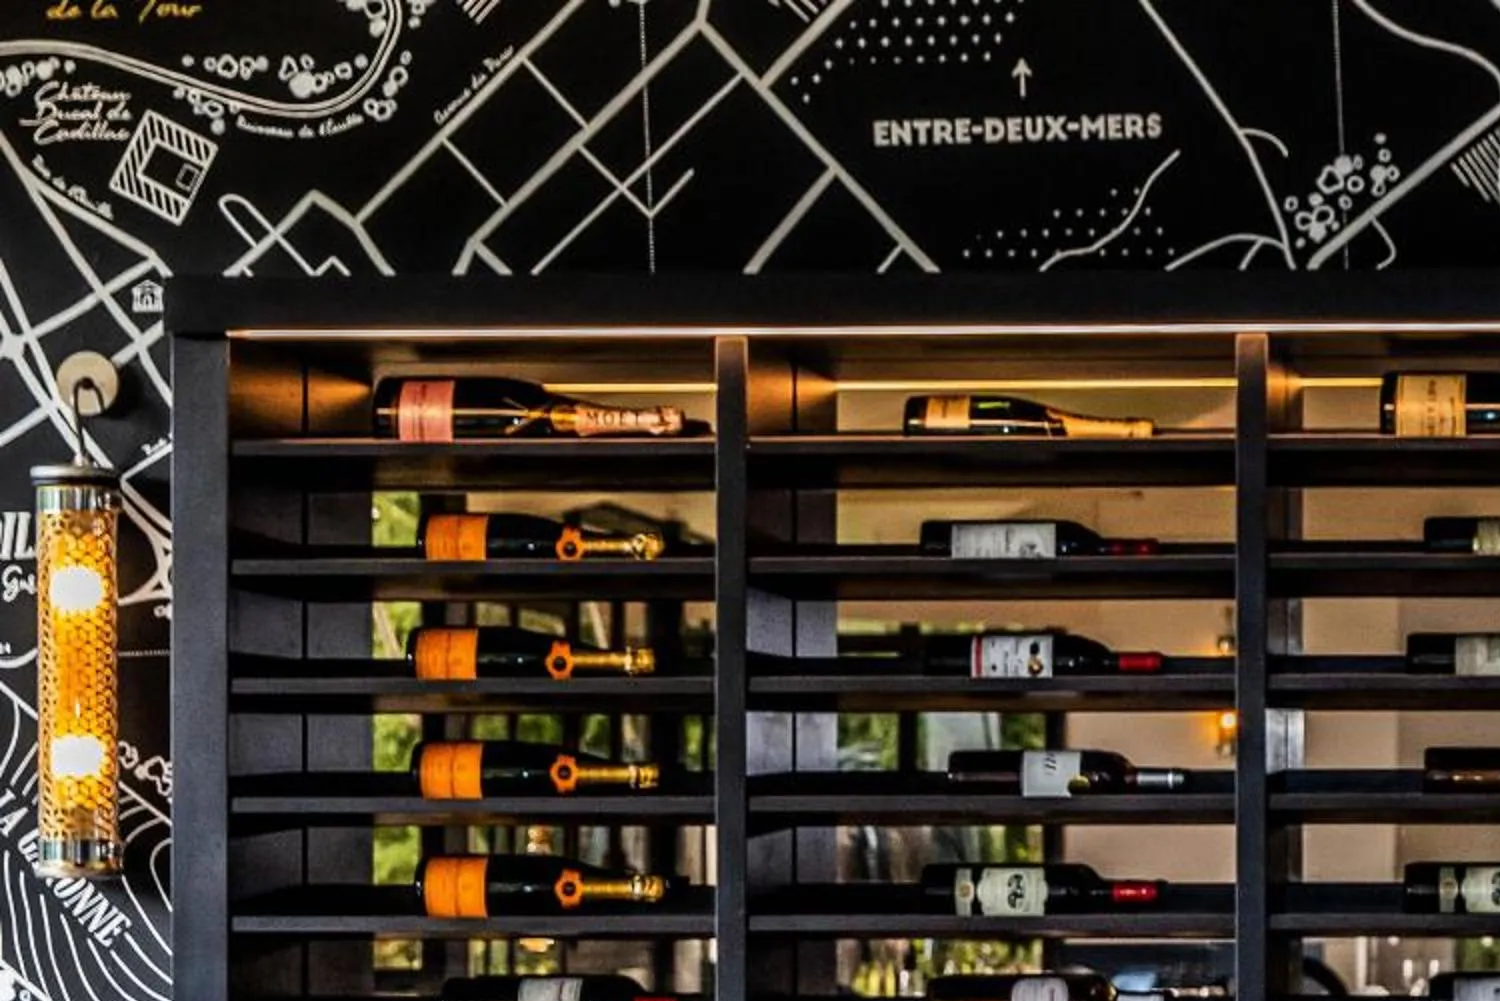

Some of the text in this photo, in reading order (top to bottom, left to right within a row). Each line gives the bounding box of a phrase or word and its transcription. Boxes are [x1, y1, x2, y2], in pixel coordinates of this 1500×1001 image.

[105, 101, 132, 120] de
[33, 119, 131, 145] Cadillac
[872, 112, 1163, 147] ENTRE-DEUX-MERS
